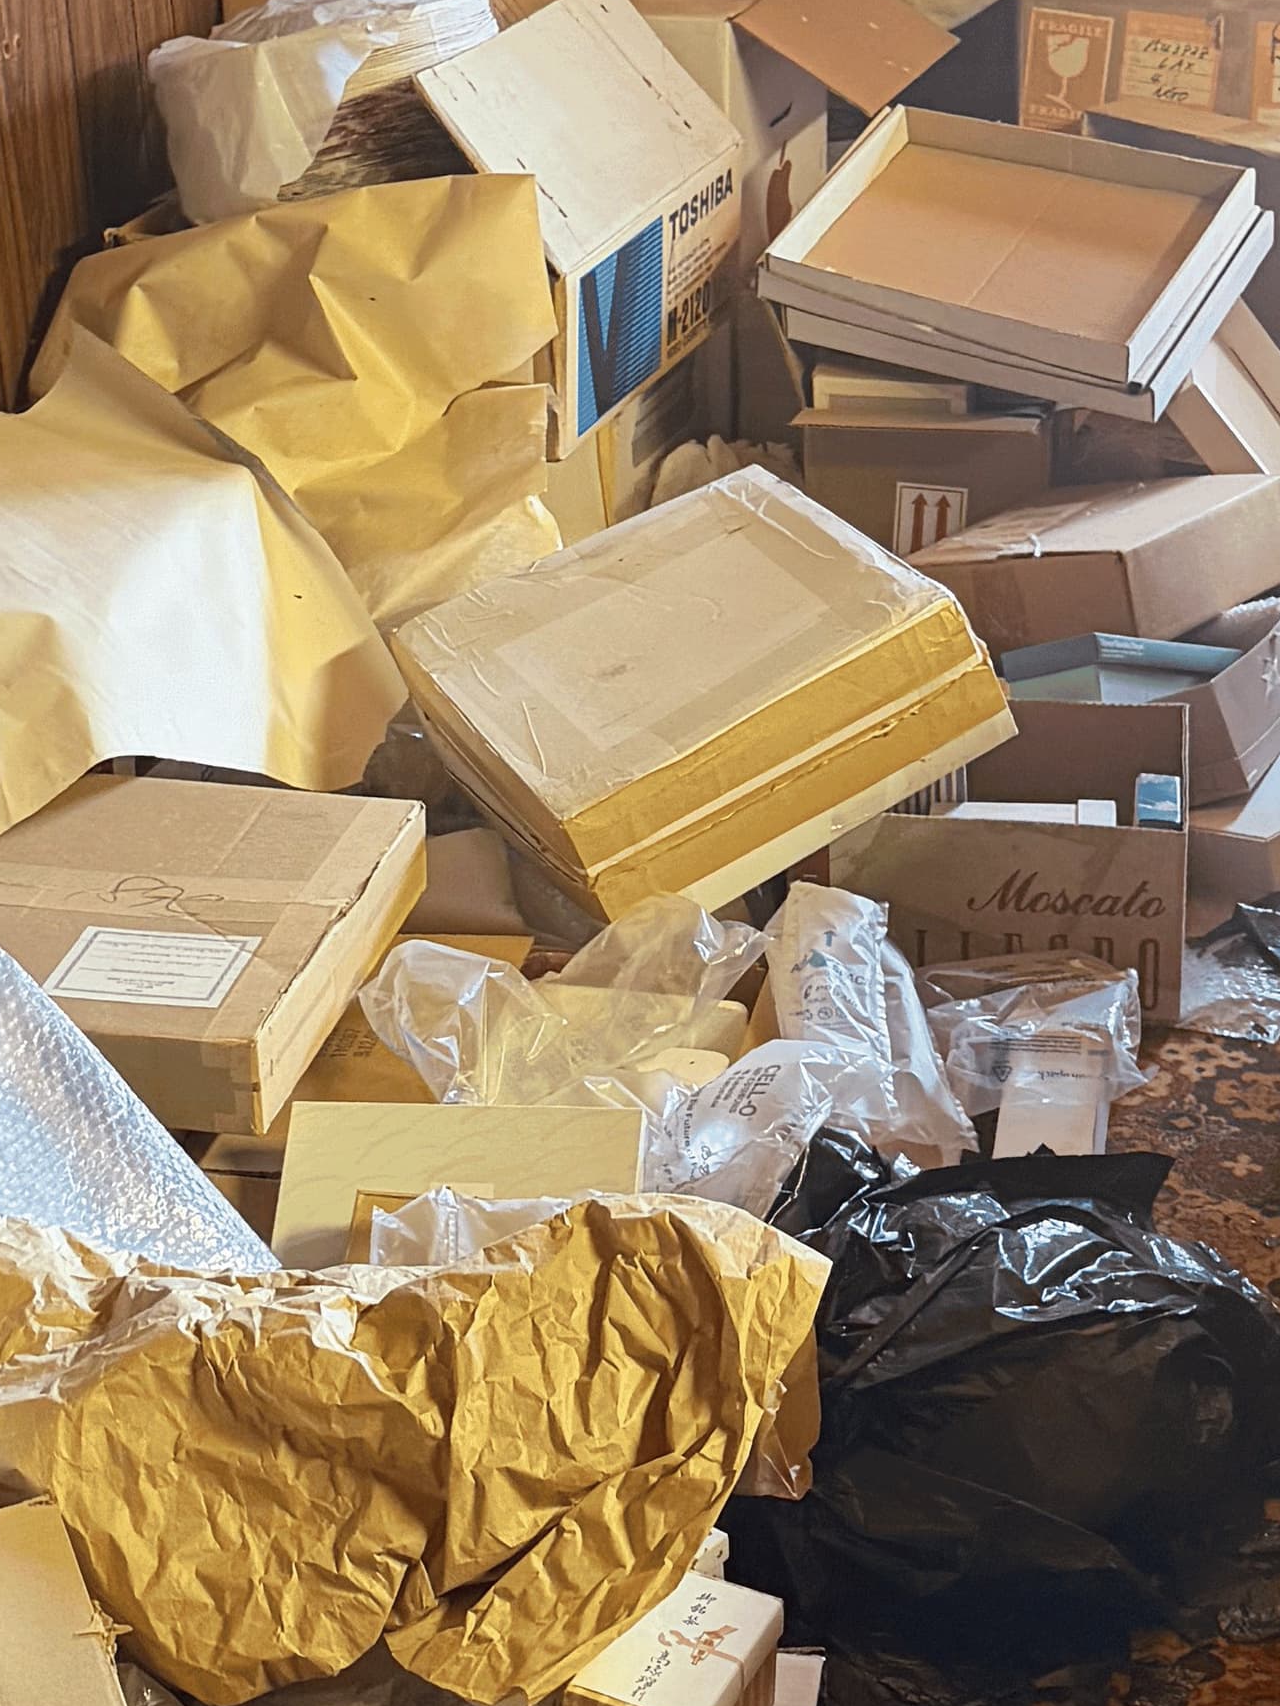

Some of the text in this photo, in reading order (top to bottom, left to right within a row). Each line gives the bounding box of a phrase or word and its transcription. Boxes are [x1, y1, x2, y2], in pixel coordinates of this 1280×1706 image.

[1038, 19, 1105, 38] FRAGILE
[668, 168, 734, 242] TOSHIBA
[966, 867, 1167, 921] Moscato
